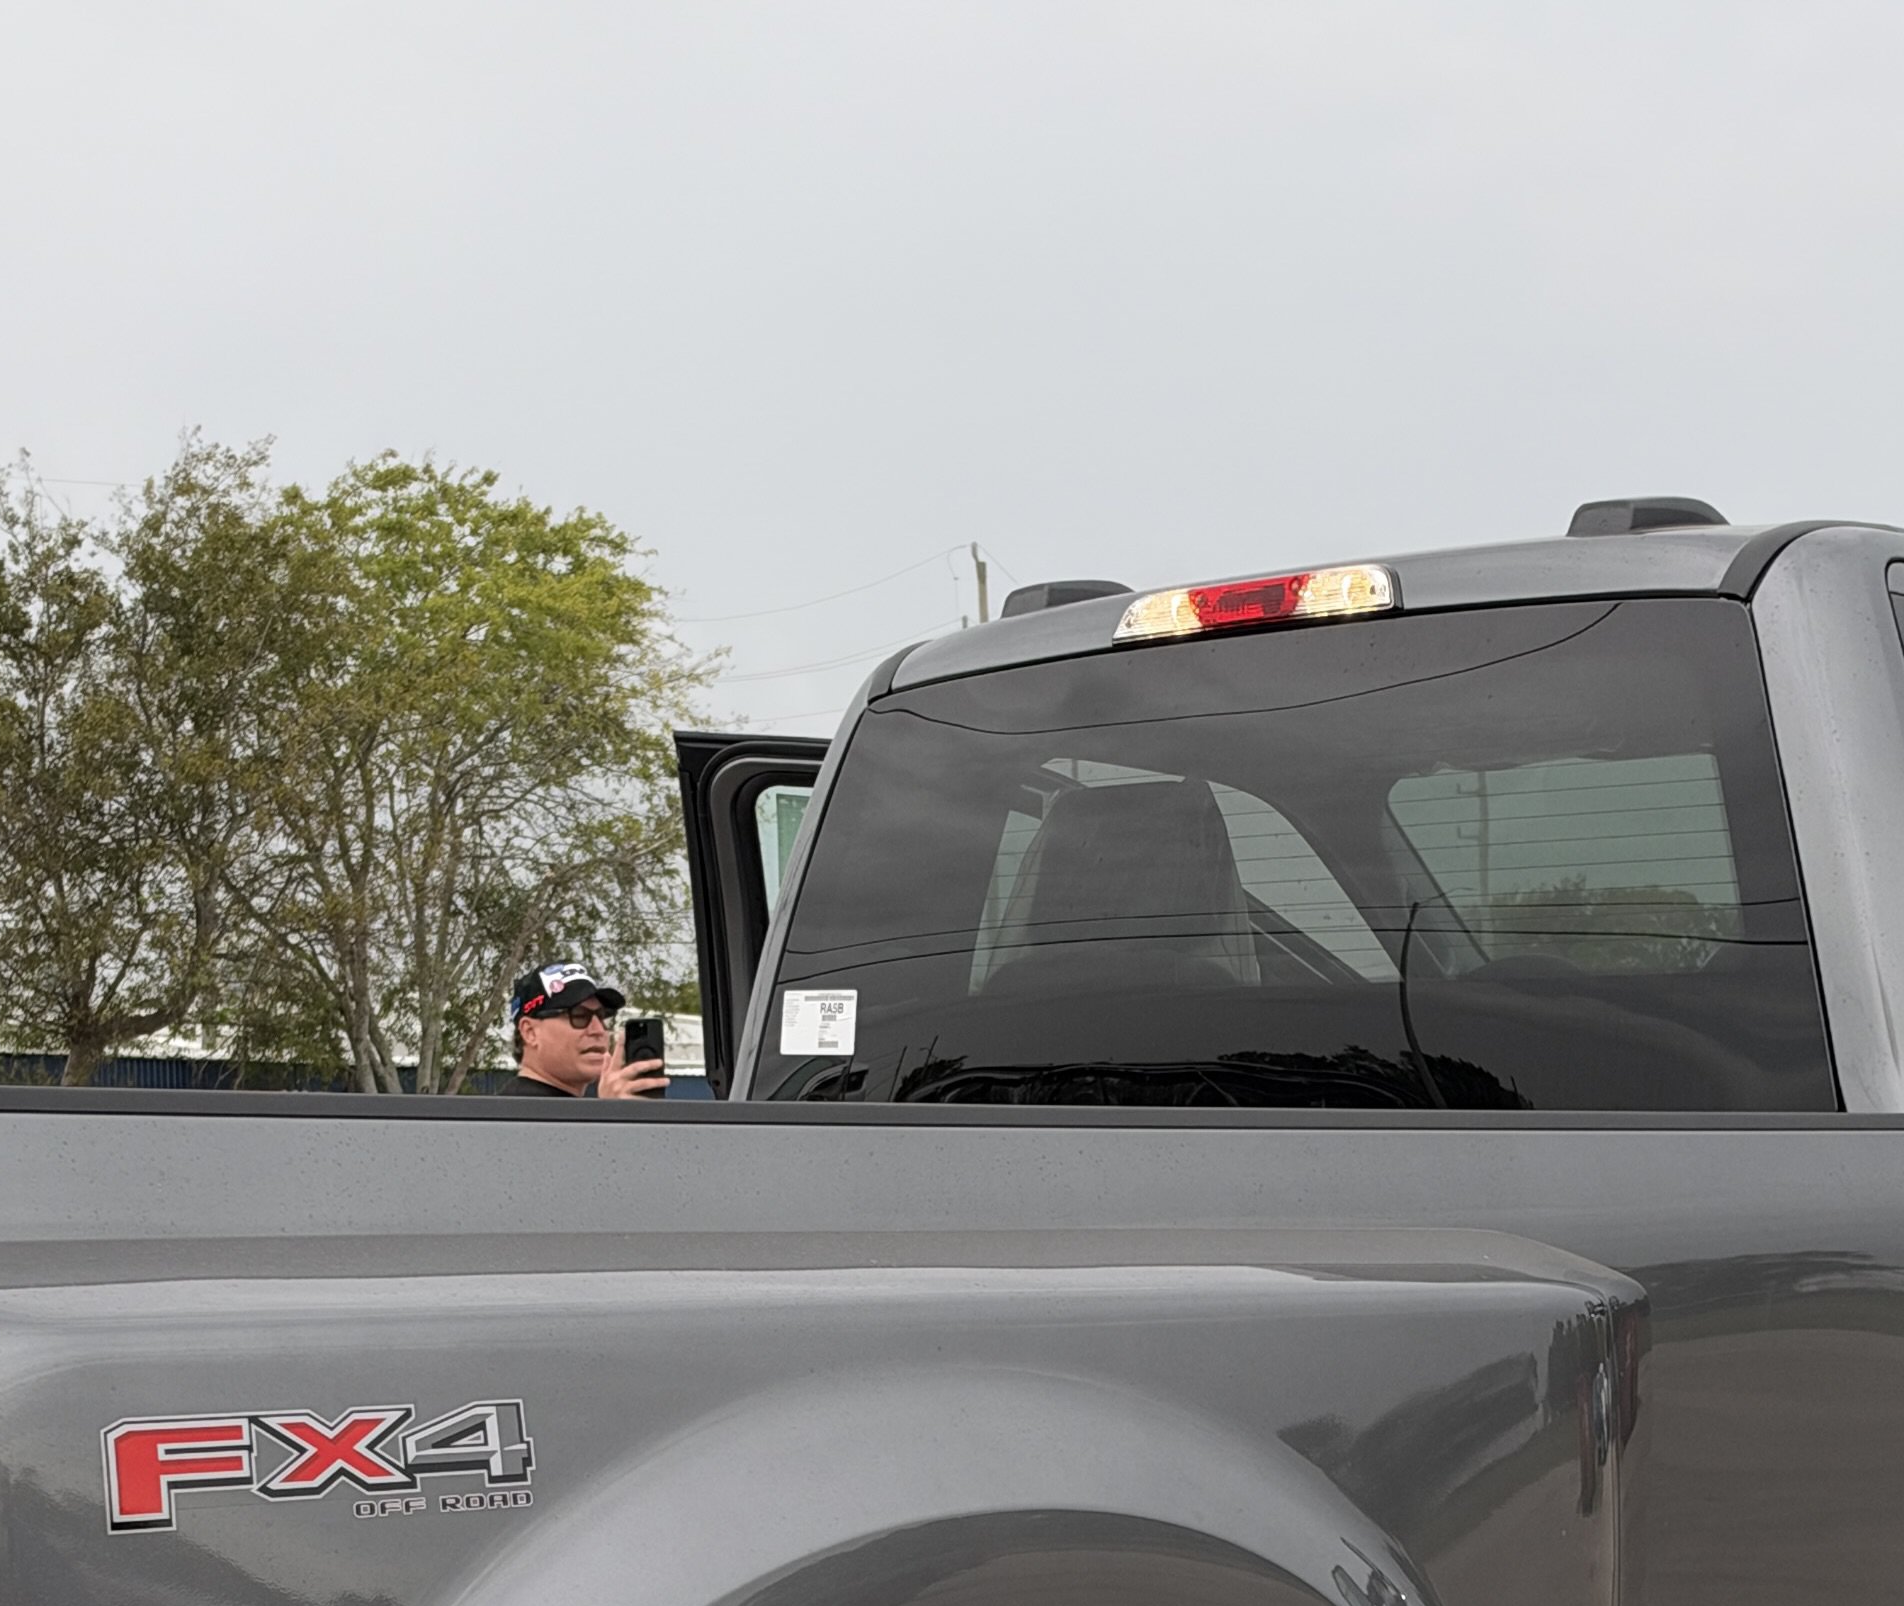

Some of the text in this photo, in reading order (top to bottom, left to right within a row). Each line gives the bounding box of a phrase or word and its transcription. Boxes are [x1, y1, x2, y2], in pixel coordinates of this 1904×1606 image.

[100, 1397, 536, 1536] FX4
[353, 1489, 535, 1519] OFF ROAD
